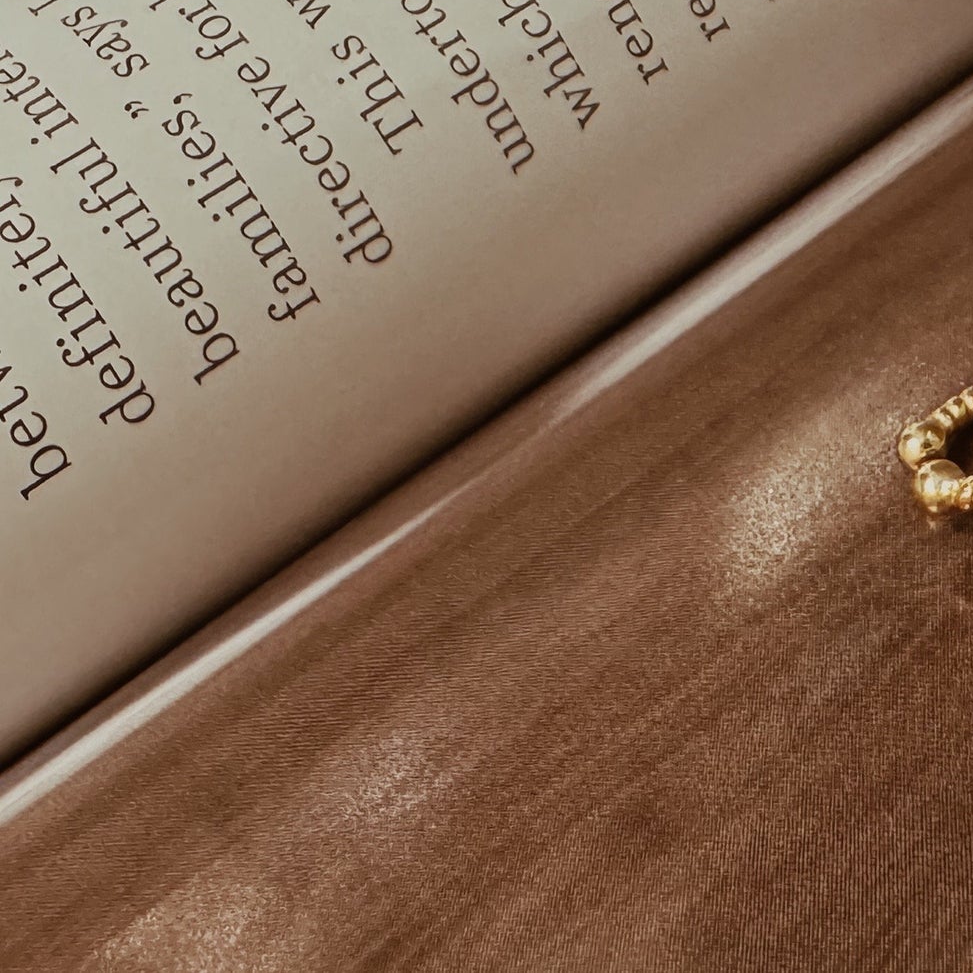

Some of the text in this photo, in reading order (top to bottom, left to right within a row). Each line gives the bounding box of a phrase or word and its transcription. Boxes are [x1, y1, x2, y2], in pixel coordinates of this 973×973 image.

[60, 5, 150, 78] says
[178, 0, 250, 61] for
[331, 35, 424, 156] This
[124, 93, 320, 322] families,”
[237, 56, 393, 264] directive
[50, 138, 239, 384] beautiful
